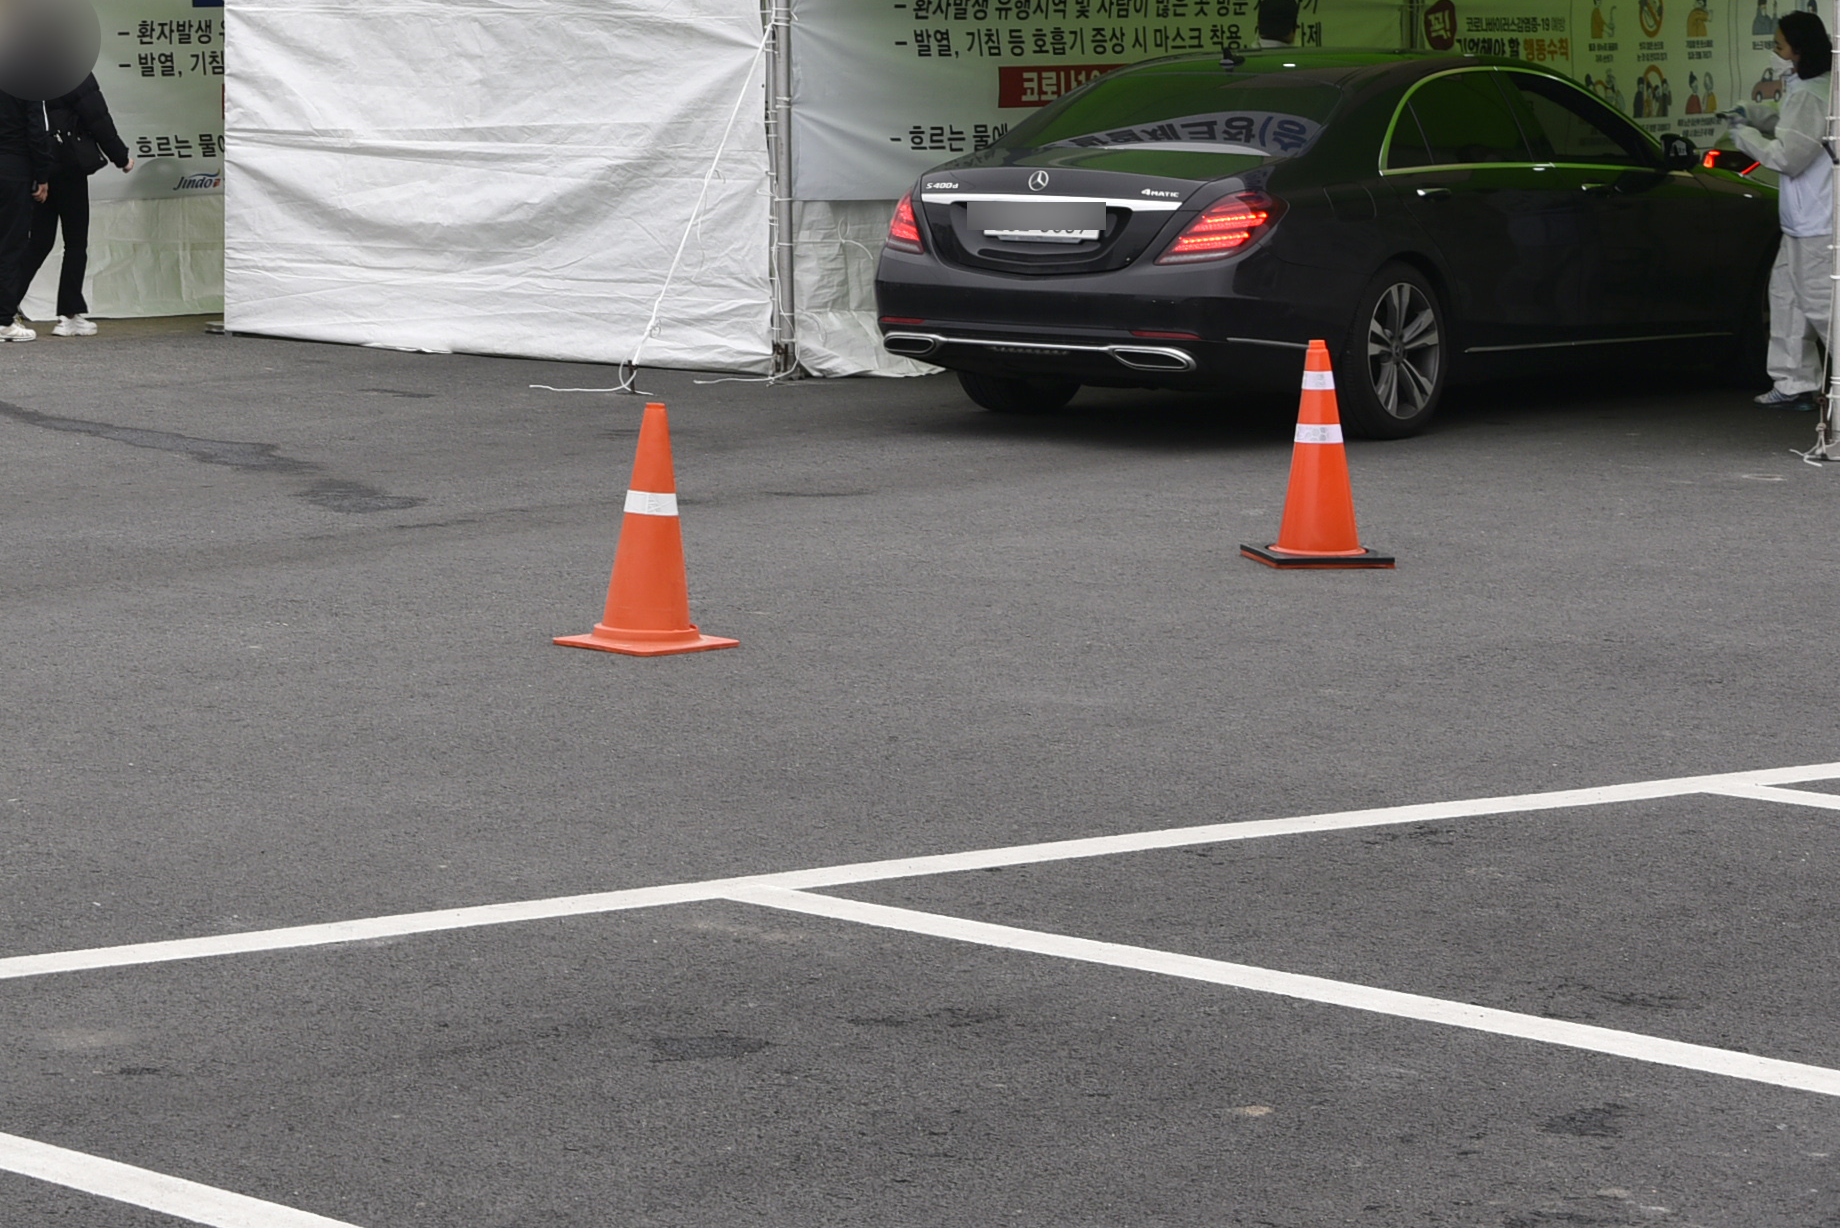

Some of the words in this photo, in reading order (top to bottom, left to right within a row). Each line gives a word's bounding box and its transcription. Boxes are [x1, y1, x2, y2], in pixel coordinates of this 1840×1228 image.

[136, 20, 213, 45] 환자발생
[913, 28, 959, 58] 발열,
[965, 28, 1002, 57] 기침
[1008, 28, 1025, 56] 등
[1032, 27, 1085, 55] 호흡기
[1091, 26, 1125, 54] 증상
[1132, 25, 1147, 53] 시
[1154, 25, 1204, 53] 마스크
[1523, 38, 1569, 61] 행동수칙
[138, 51, 183, 77] 발열,
[136, 134, 193, 158] 흐르는
[908, 124, 966, 152] 흐르는
[173, 176, 214, 191] Jindo
[1141, 188, 1180, 198] 4MATIC
